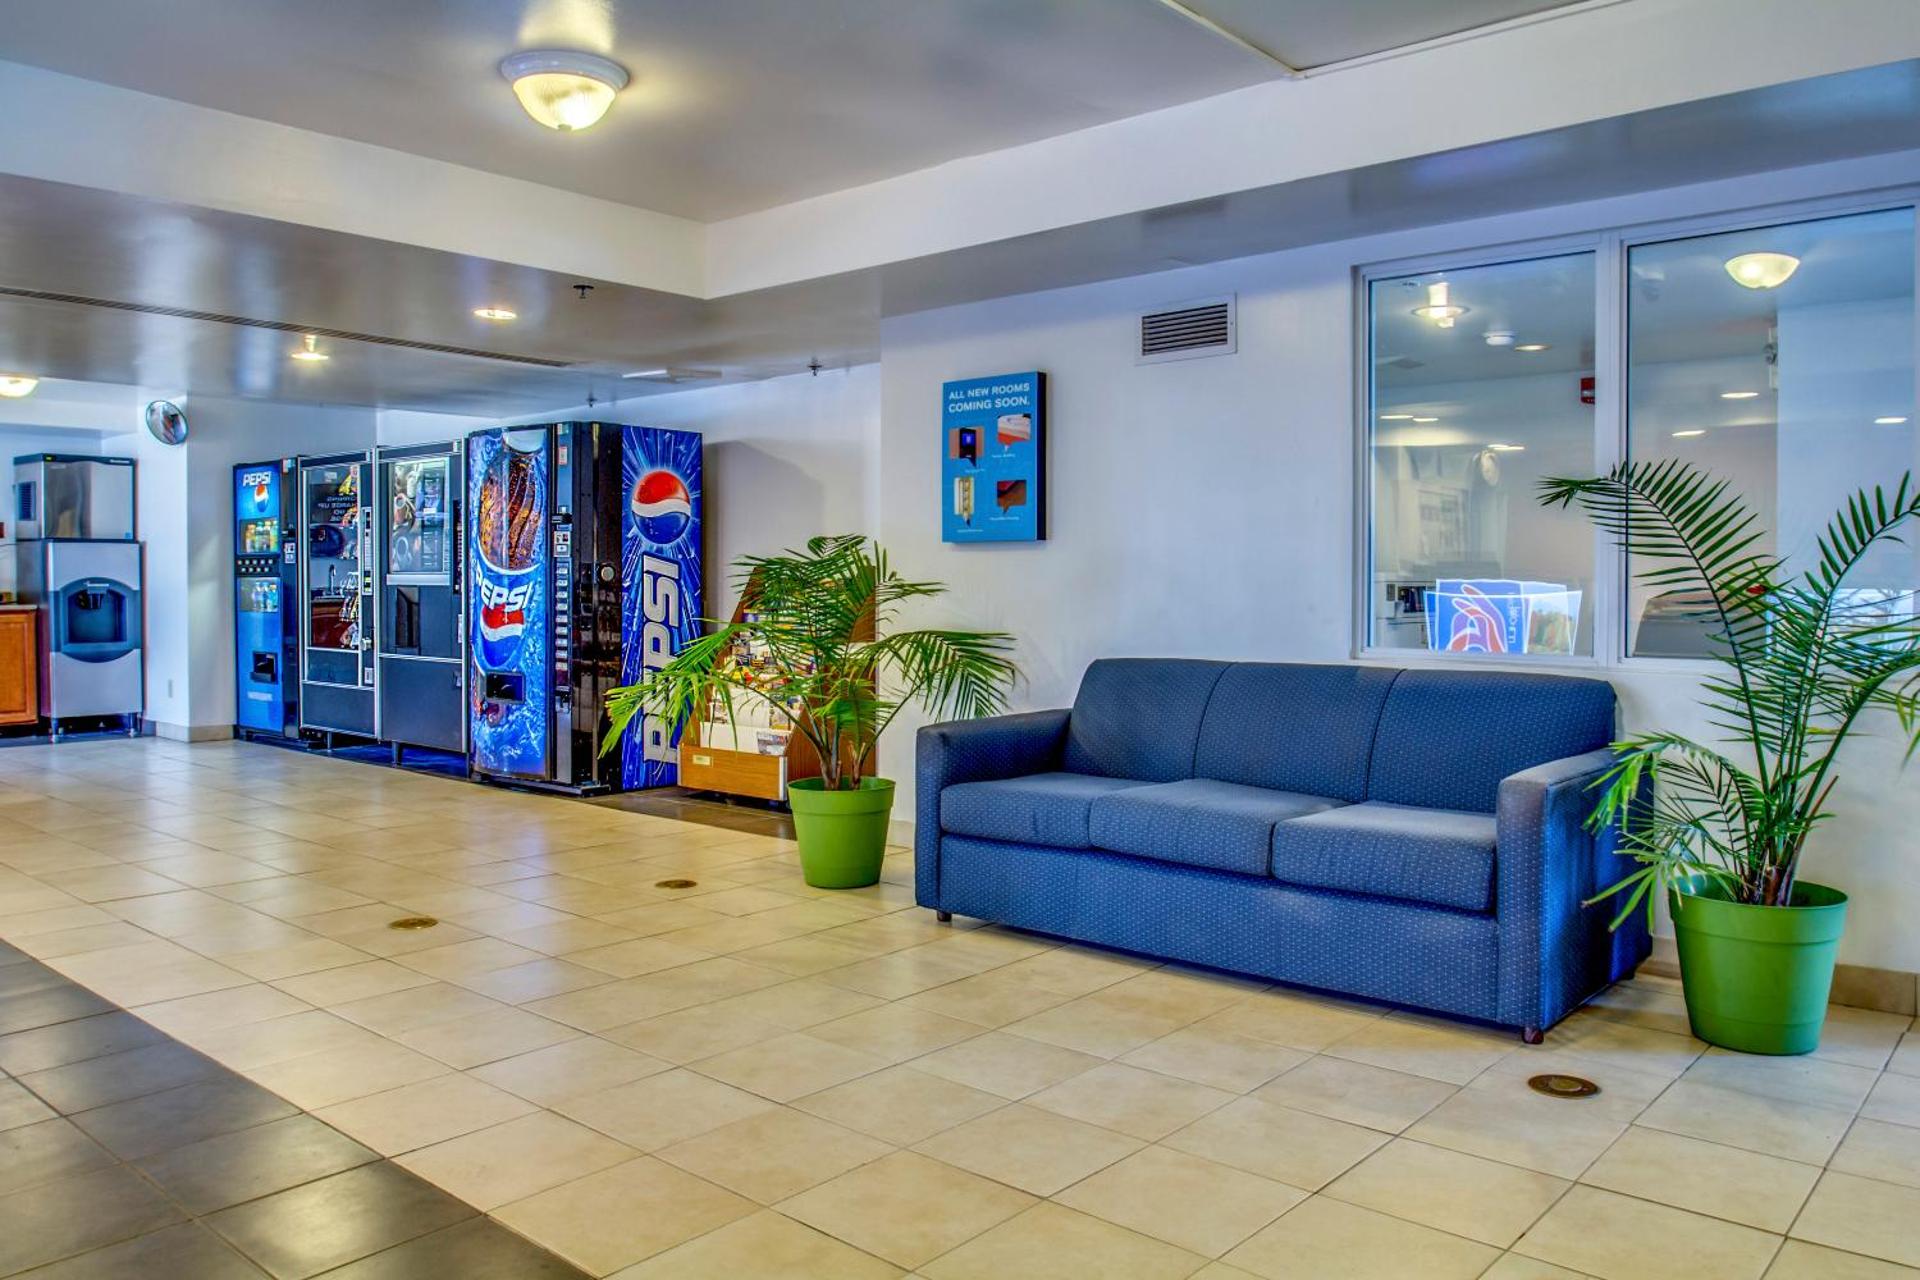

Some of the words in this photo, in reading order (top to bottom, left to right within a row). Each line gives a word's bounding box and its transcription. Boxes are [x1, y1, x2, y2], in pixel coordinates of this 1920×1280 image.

[949, 391, 965, 400] ALL
[967, 387, 989, 397] NEW
[992, 382, 1030, 395] ROOMS
[948, 399, 992, 413] COMING
[995, 395, 1030, 408] SOON.
[242, 470, 272, 487] PEPSI
[476, 559, 534, 613] PEPSI
